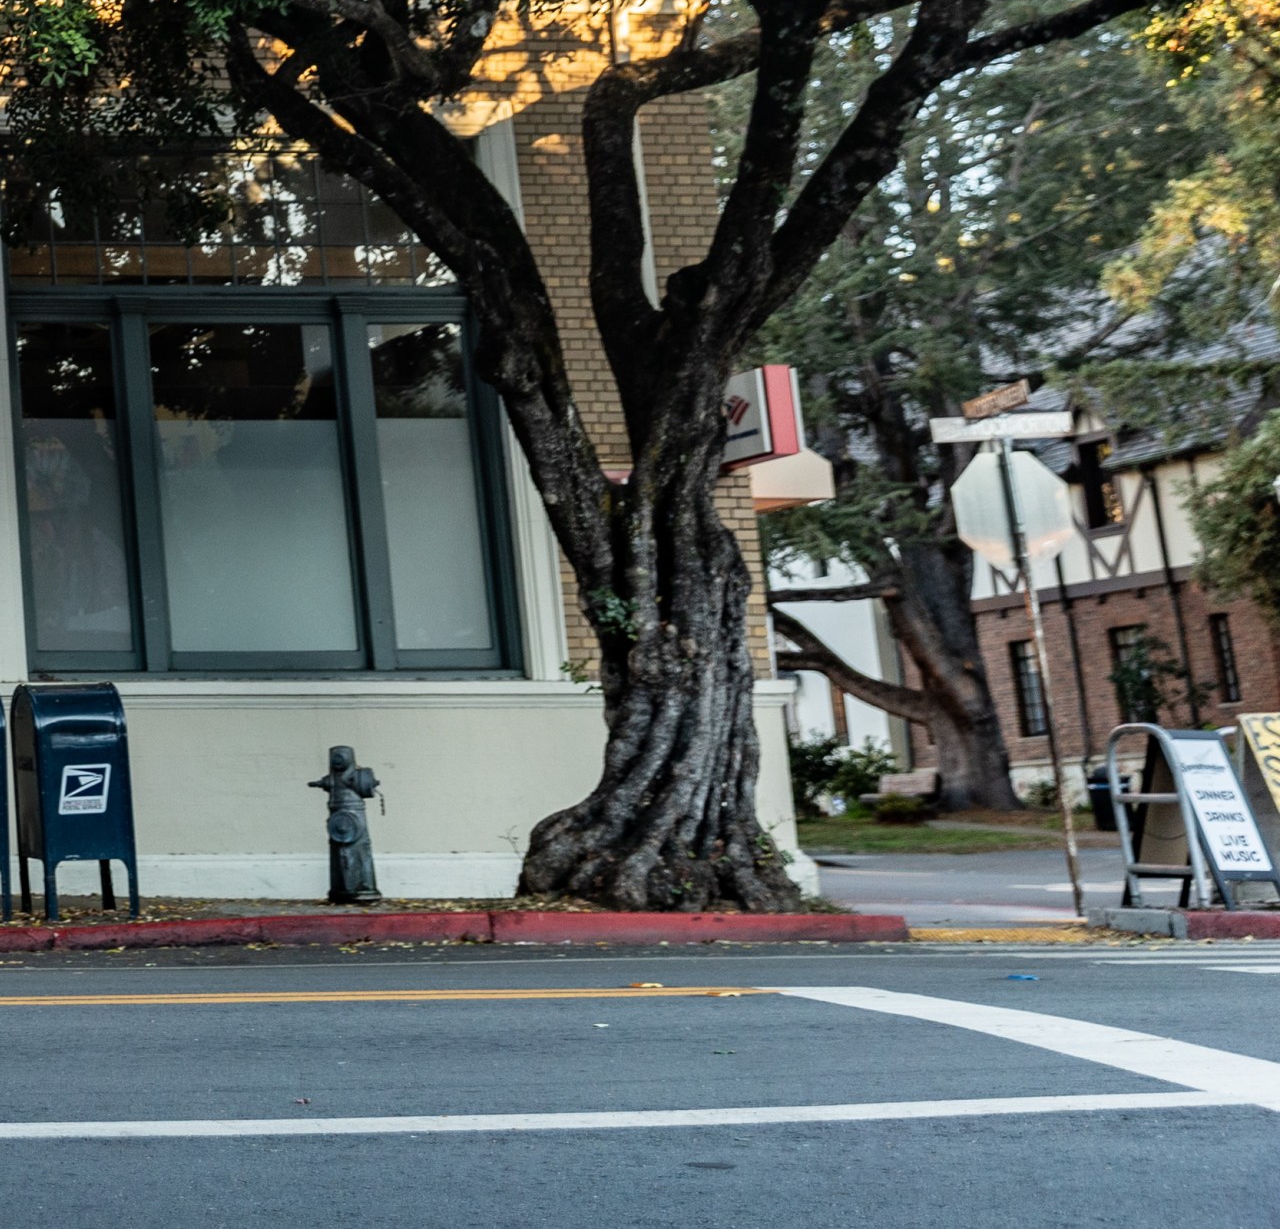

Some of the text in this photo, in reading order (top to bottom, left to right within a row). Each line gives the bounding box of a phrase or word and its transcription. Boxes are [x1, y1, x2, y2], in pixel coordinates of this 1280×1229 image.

[1195, 790, 1237, 800] DINNER
[1205, 812, 1245, 822] DRINKS
[1220, 834, 1249, 847] LIVE
[1220, 851, 1261, 863] MUSIC
